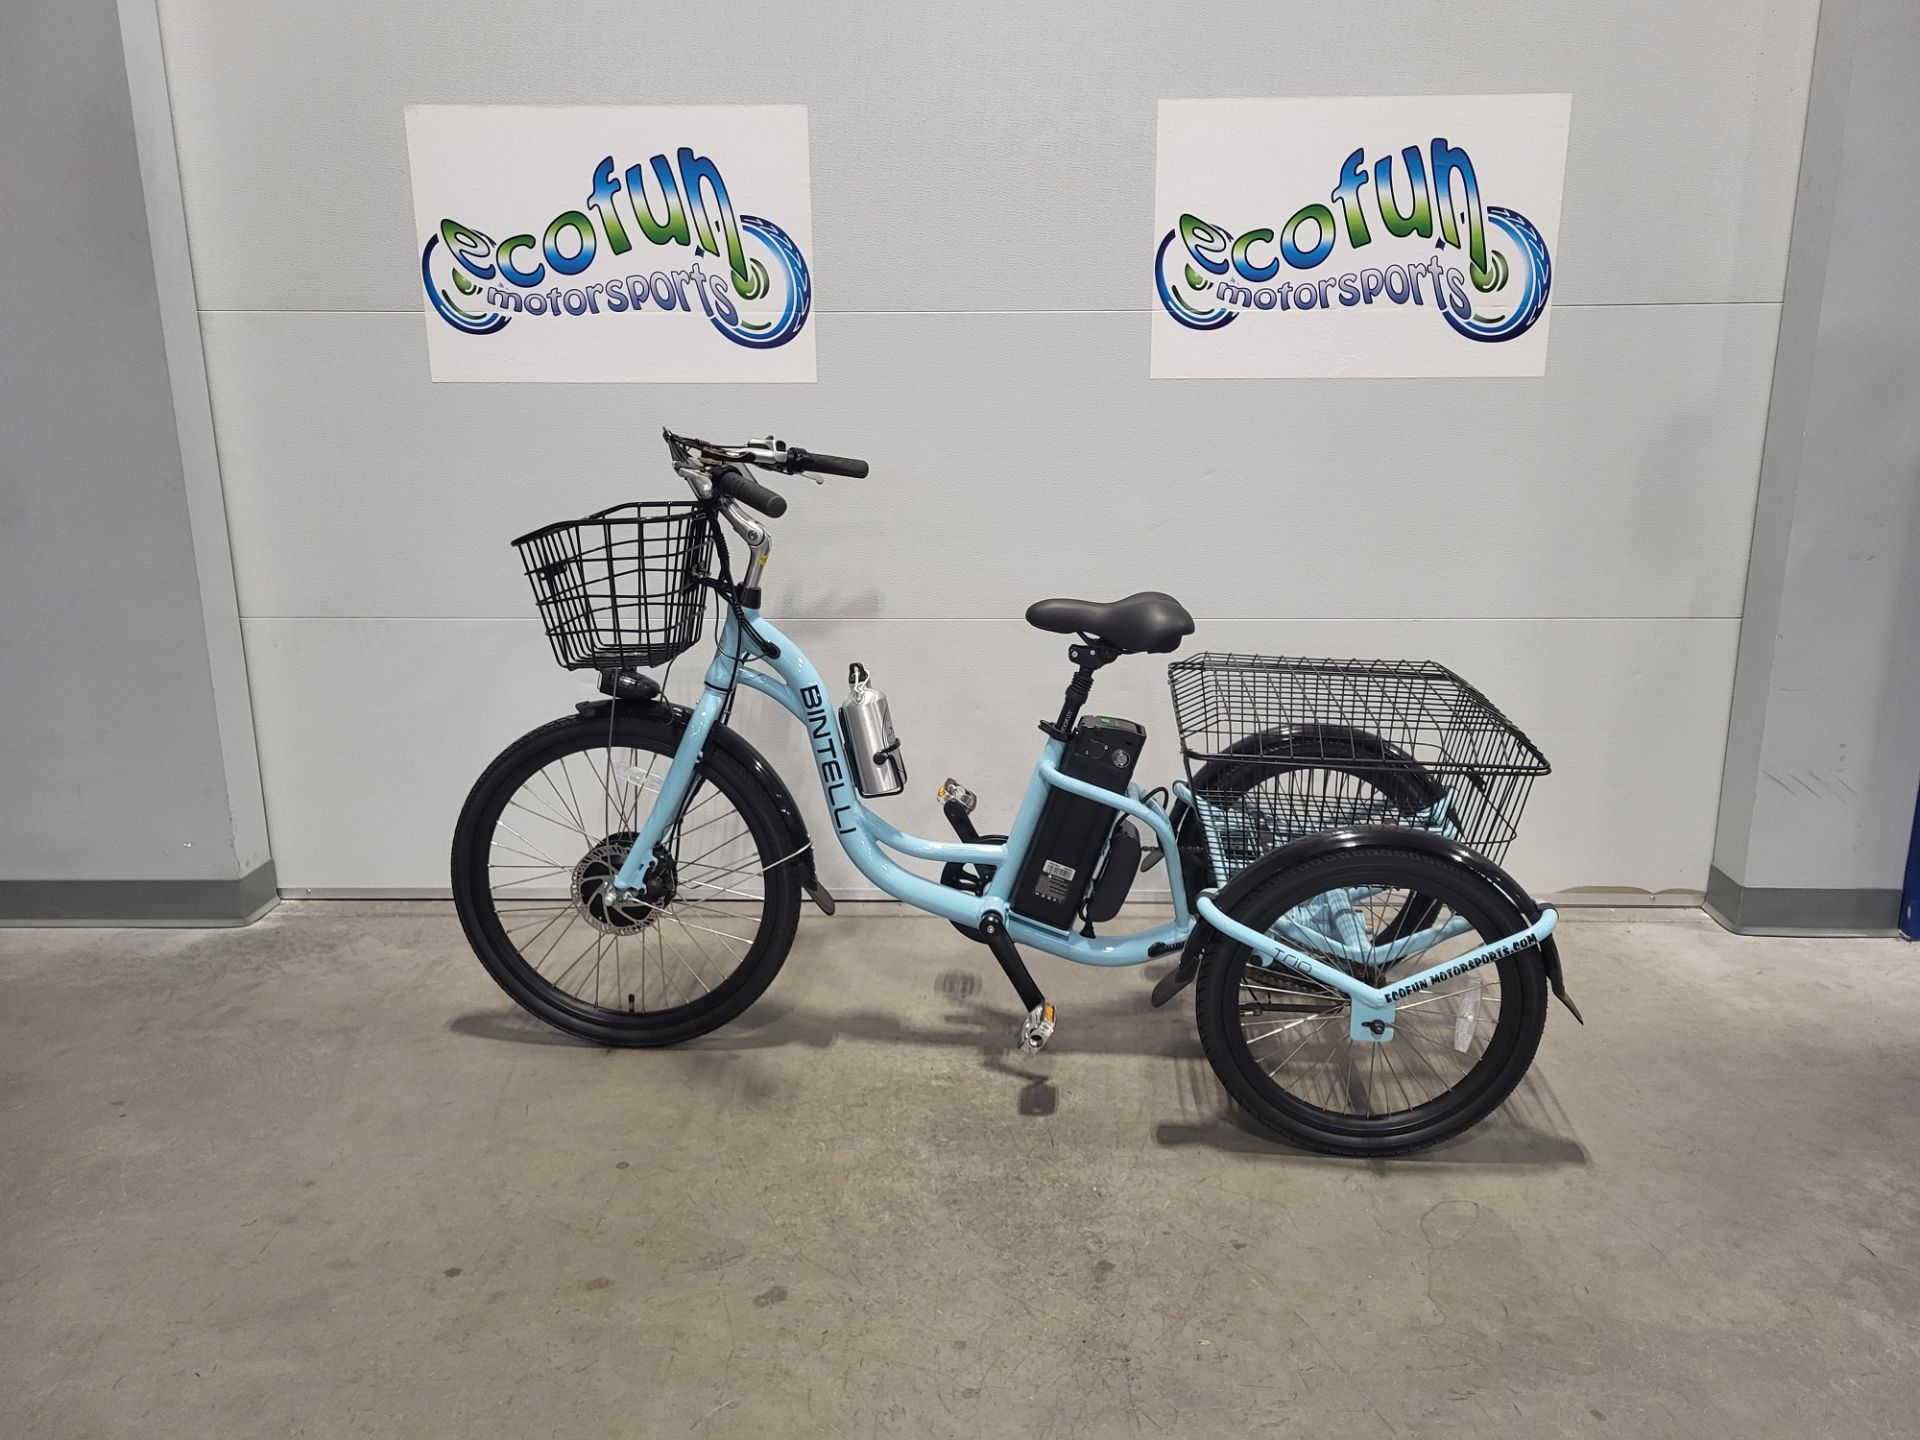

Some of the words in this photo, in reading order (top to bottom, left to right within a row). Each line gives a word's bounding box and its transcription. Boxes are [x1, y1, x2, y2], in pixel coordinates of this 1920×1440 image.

[486, 263, 740, 327] motorsports
[1216, 255, 1473, 320] motorsports
[800, 684, 857, 835] BINTELLI
[1384, 977, 1429, 1004] ECOFUN
